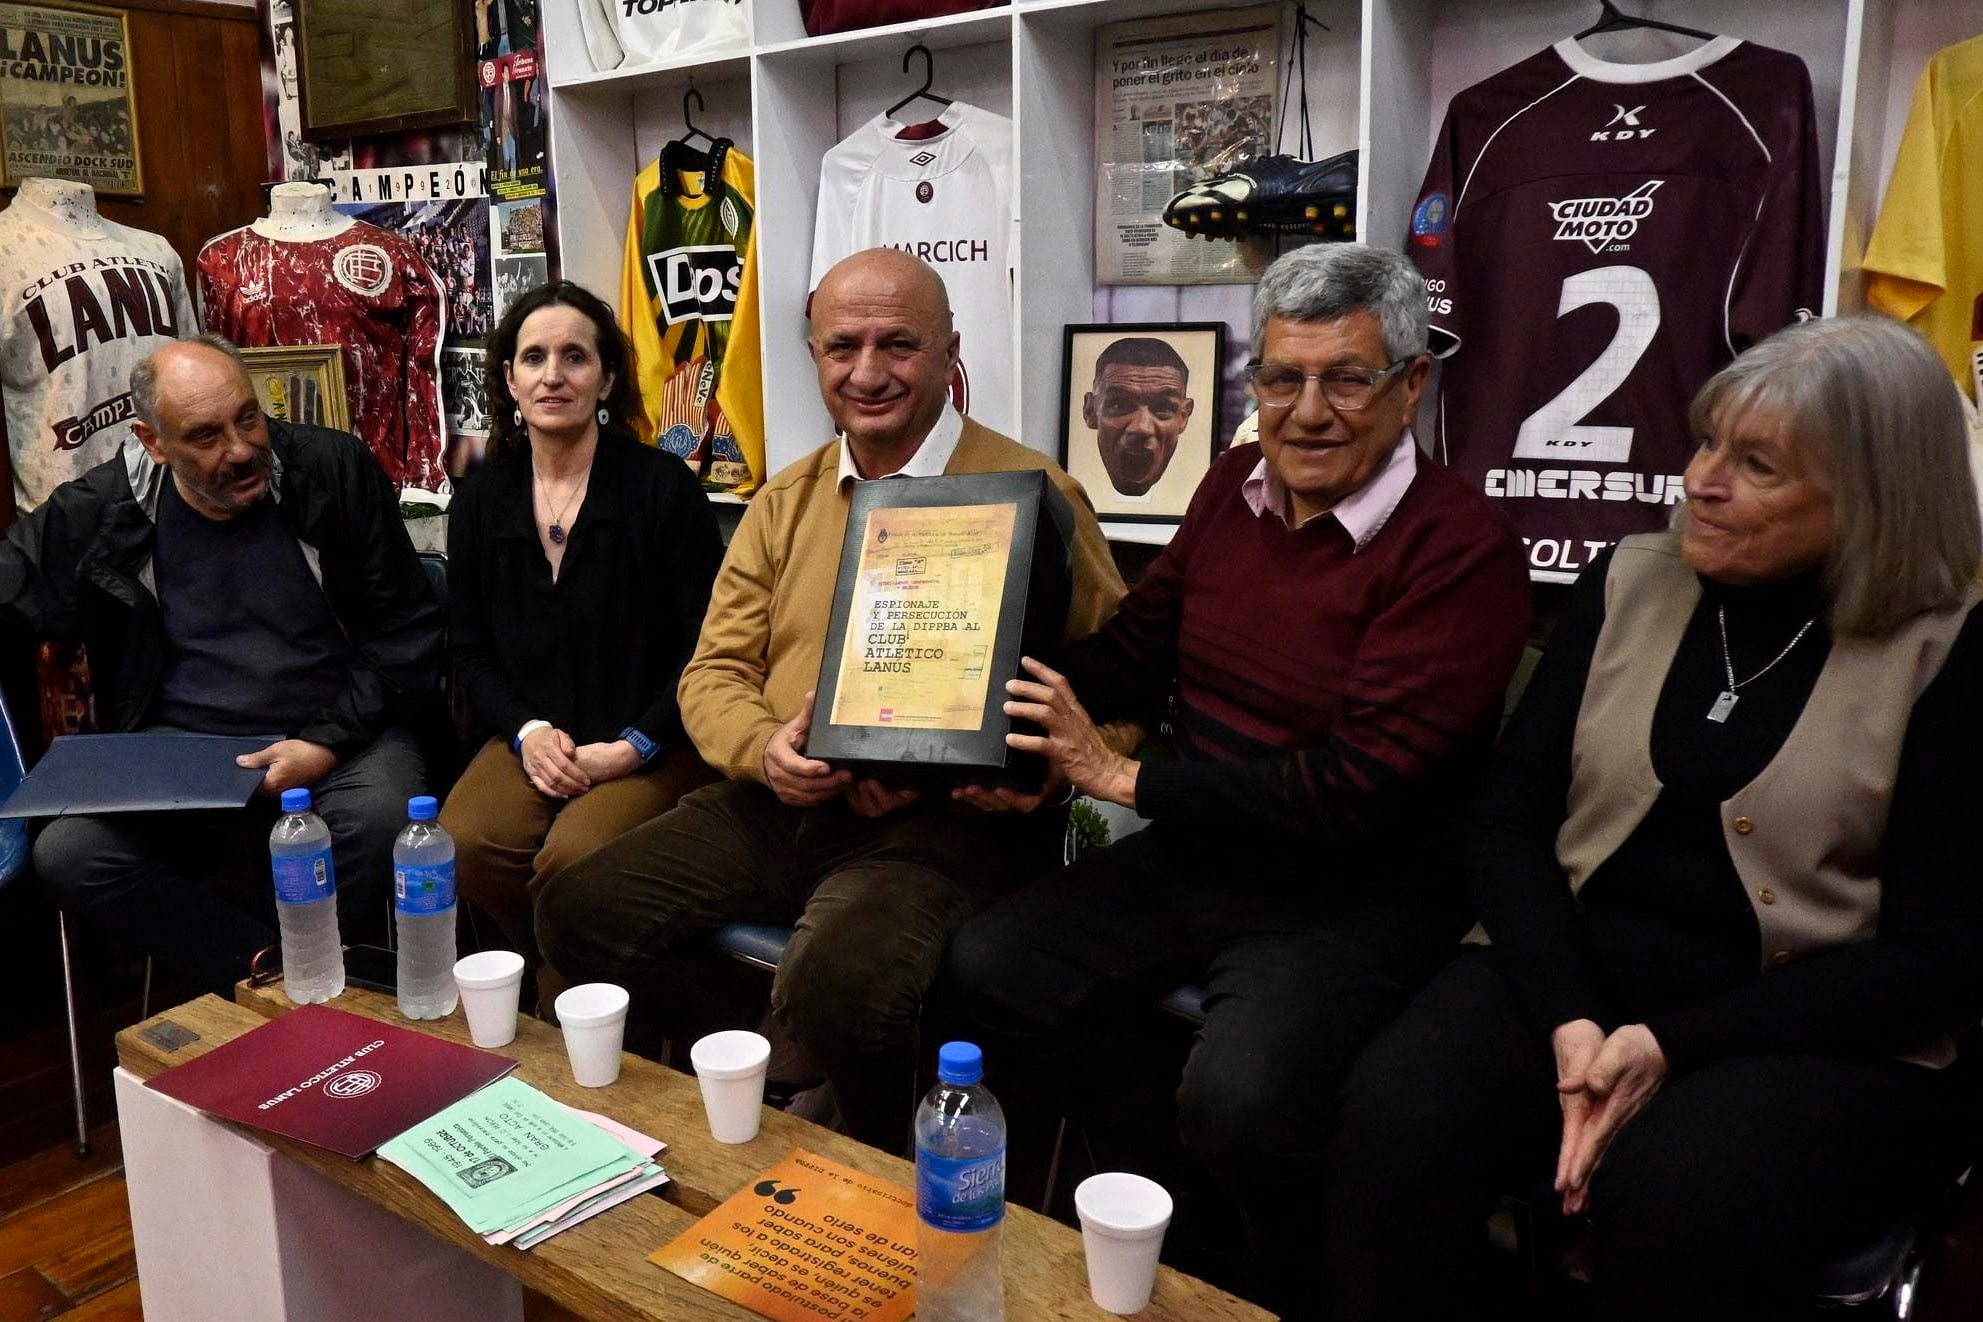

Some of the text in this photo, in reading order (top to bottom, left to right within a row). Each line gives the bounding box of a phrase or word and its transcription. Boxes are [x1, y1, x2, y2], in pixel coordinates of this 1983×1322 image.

[0, 27, 124, 70] LANUS
[1112, 60, 1120, 73] Y
[1122, 59, 1139, 73] por
[1142, 57, 1158, 68] fin
[1195, 52, 1206, 63] el
[1112, 73, 1145, 90] poner
[1148, 71, 1160, 84] el
[1162, 67, 1192, 86] grito
[1213, 65, 1225, 78] el
[1590, 128, 1657, 142] KDY
[74, 156, 107, 168] DOCK
[1557, 200, 1650, 218] CIUDAD
[1559, 220, 1634, 237] MOTO
[883, 239, 988, 262] ARCICH
[1605, 243, 1630, 252] .com
[22, 262, 86, 300] CLUB
[25, 267, 179, 374] LANU
[1513, 265, 1661, 463] 2
[1545, 440, 1593, 448] KDY
[874, 600, 940, 609] ESPIONAJE
[873, 611, 880, 619] Y
[870, 622, 981, 631] DE LA DIPPBA AL
[868, 633, 906, 645] CLUB
[354, 1040, 385, 1057] CLUB
[258, 1087, 302, 1110] LANUS
[500, 1113, 523, 1130] ACTO
[524, 1131, 550, 1151] GRAN
[764, 1205, 824, 1234] cuando
[823, 1215, 863, 1235] serlo
[732, 1221, 754, 1237] los
[826, 1232, 856, 1248] son
[865, 1233, 888, 1245] de
[747, 1243, 789, 1266] decir,
[756, 1219, 911, 1289] buenos, para saber
[770, 1239, 851, 1278] registrado
[743, 1259, 787, 1280] saber
[790, 1264, 809, 1275] es
[700, 1253, 842, 1319] postulado parte de
[788, 1280, 809, 1290] de
[850, 1277, 896, 1299] tener
[811, 1289, 850, 1310] base
[862, 1296, 882, 1308] es
[852, 1307, 869, 1319] la
